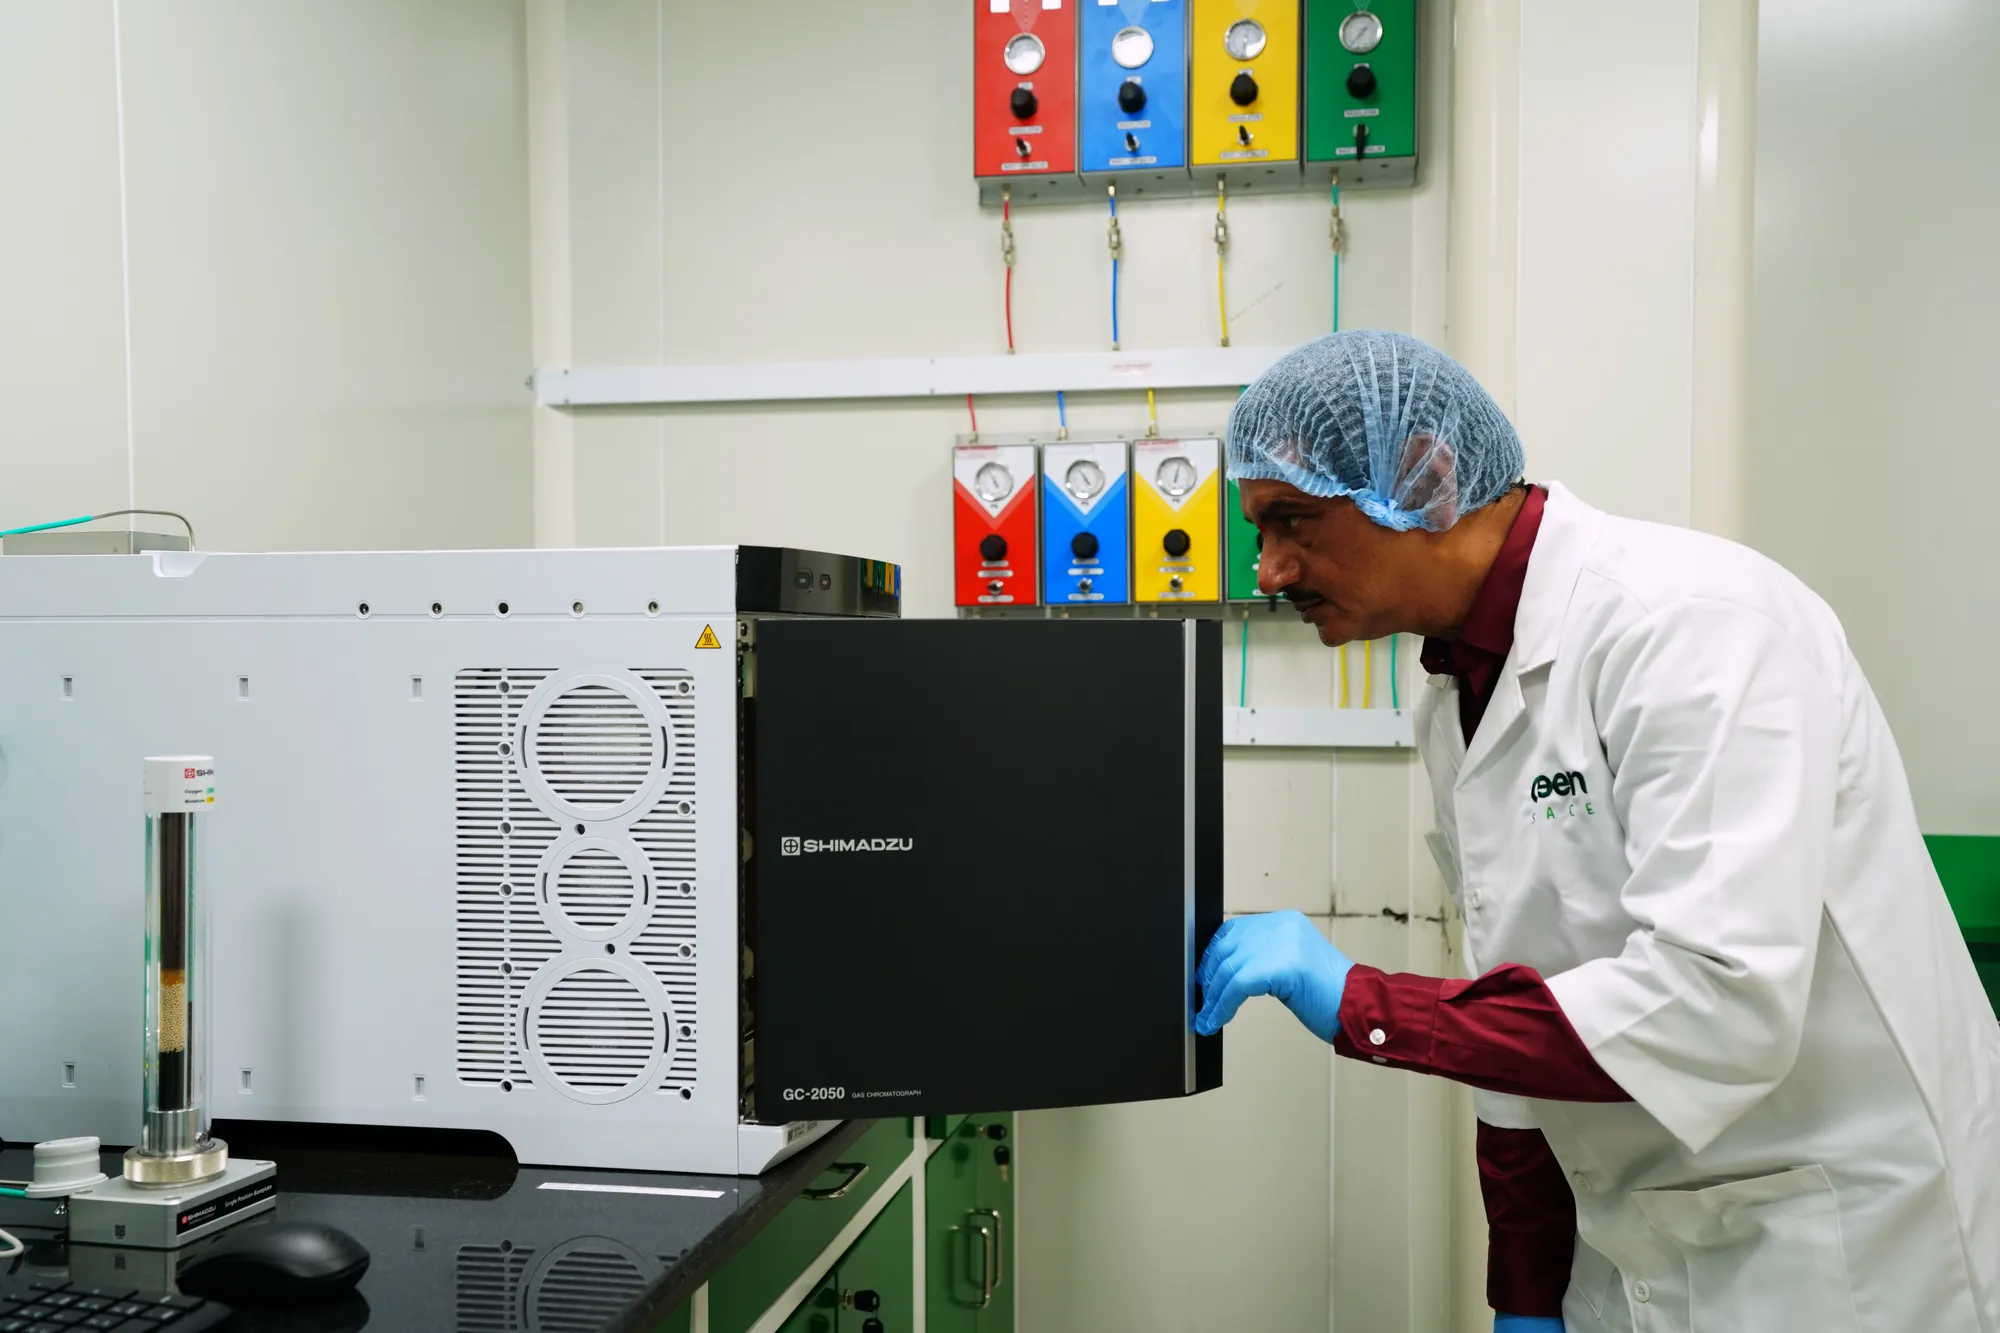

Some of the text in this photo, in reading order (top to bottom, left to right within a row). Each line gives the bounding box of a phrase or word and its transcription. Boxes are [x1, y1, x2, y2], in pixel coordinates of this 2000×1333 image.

[803, 838, 913, 853] SHIMADZU
[783, 1087, 845, 1100] GC-2050
[866, 1090, 922, 1098] CHROMATOGRAPH
[224, 1184, 273, 1208] Single Position Baseplate
[187, 1205, 217, 1221] SHIMADZU
